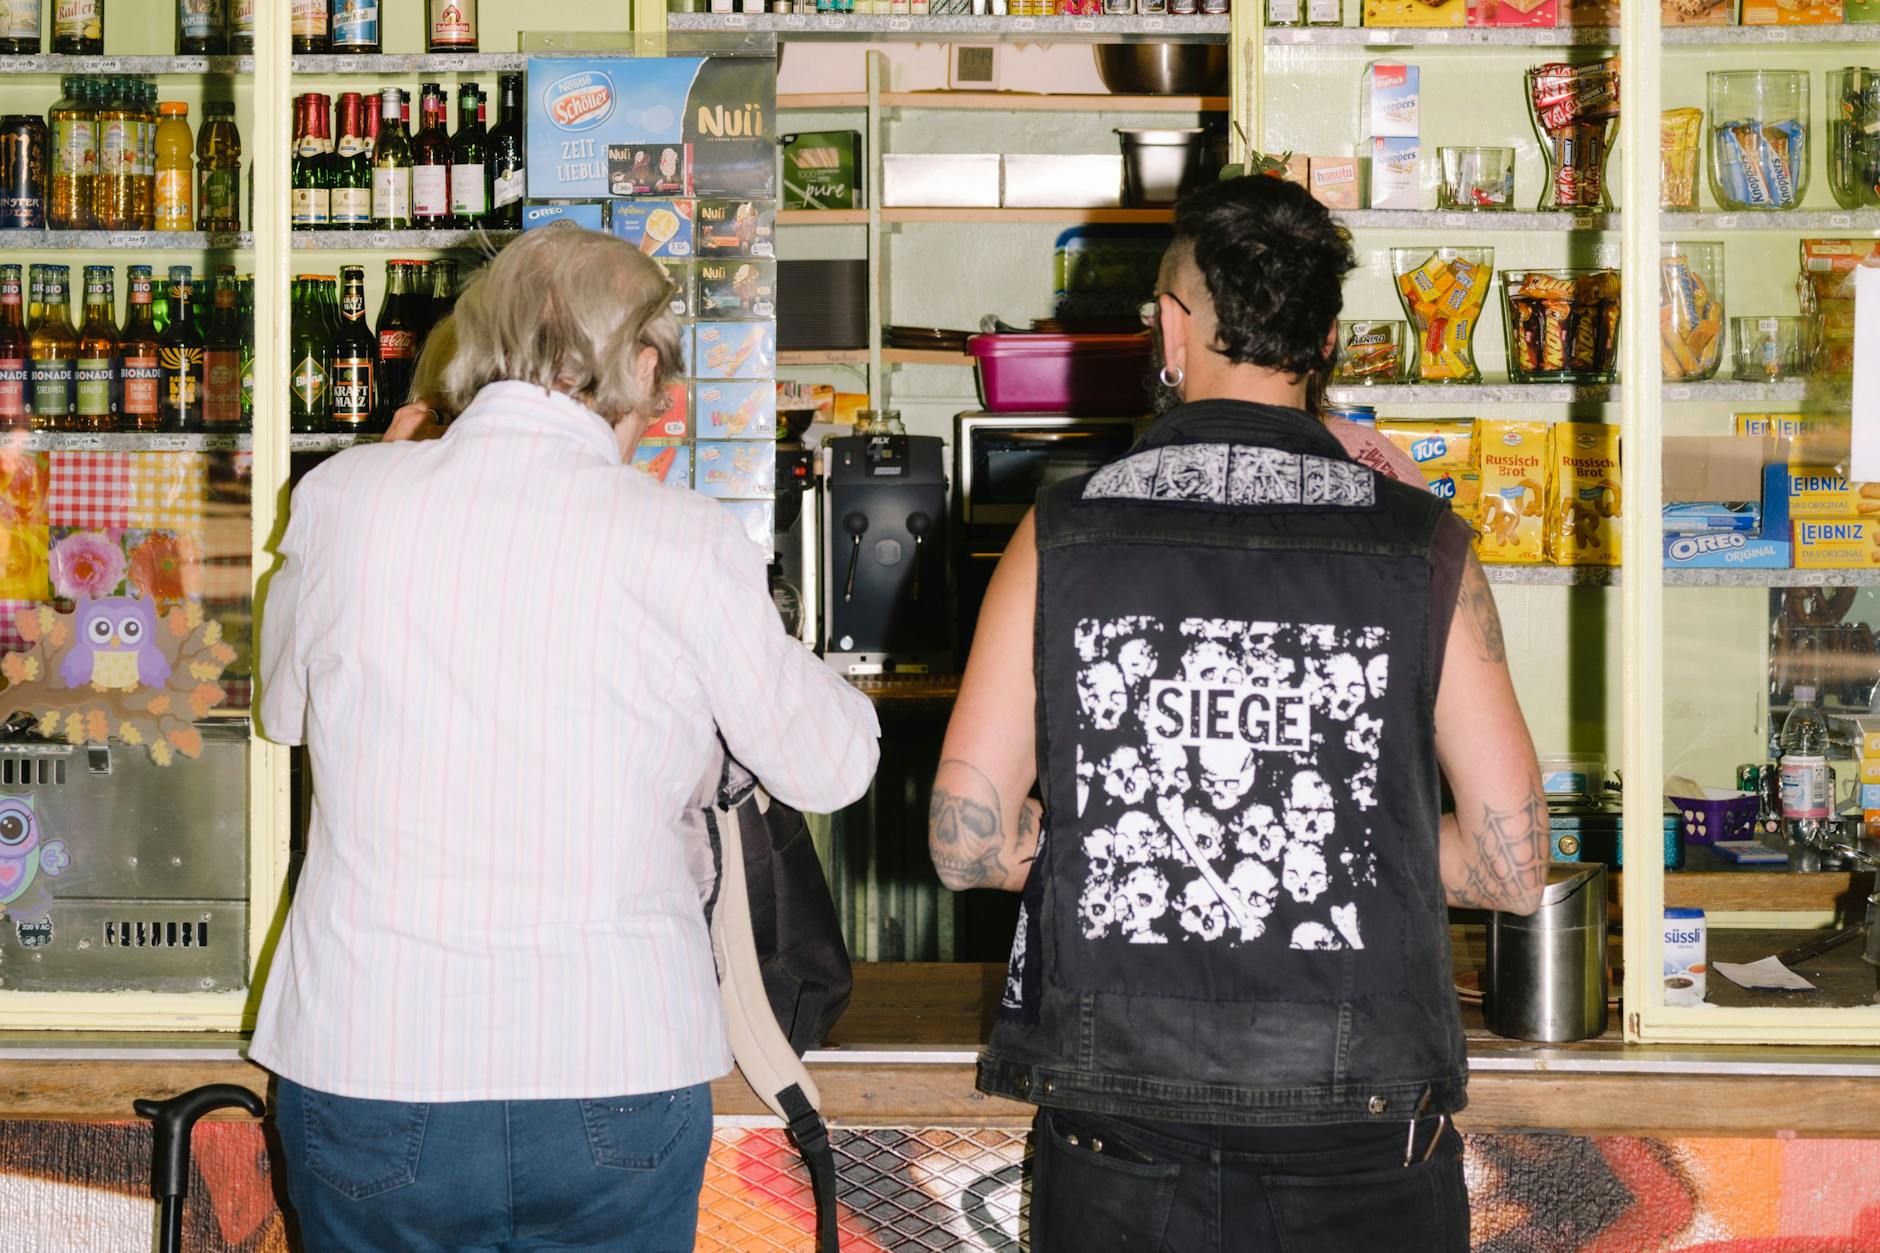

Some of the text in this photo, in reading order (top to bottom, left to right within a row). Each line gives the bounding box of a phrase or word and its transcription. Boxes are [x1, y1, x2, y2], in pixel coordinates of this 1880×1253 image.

[558, 75, 593, 93] Nestlé
[556, 87, 610, 125] Schöller
[561, 138, 596, 160] ZEIT
[557, 161, 608, 182] LIEBLIN
[1316, 167, 1353, 183] hanuta
[1771, 157, 1793, 206] Knoppers
[803, 183, 845, 208] pure
[528, 207, 563, 220] OREO
[2, 284, 19, 294] BIO
[45, 285, 62, 294] BIO
[88, 284, 105, 294] BIO
[133, 282, 150, 293] BIO
[32, 370, 72, 380] BIONADE
[121, 368, 161, 378] BIONADE
[333, 386, 369, 397] KRAFT
[334, 397, 367, 408] MALZ
[1486, 454, 1539, 467] Russisch
[1562, 456, 1615, 468] Russisch
[1499, 466, 1526, 477] Brot
[1576, 467, 1605, 478] Brot
[1789, 475, 1849, 497] LEIBNIZ
[1809, 501, 1849, 510] ORIGINAL
[1802, 522, 1864, 545] LEIBNIZ
[1670, 533, 1746, 561] OREO
[1724, 545, 1777, 563] ORIGINAL
[1801, 551, 1864, 559] DAS ORIGINAL
[1155, 687, 1305, 746] SIEGE
[1664, 928, 1700, 943] süssli
